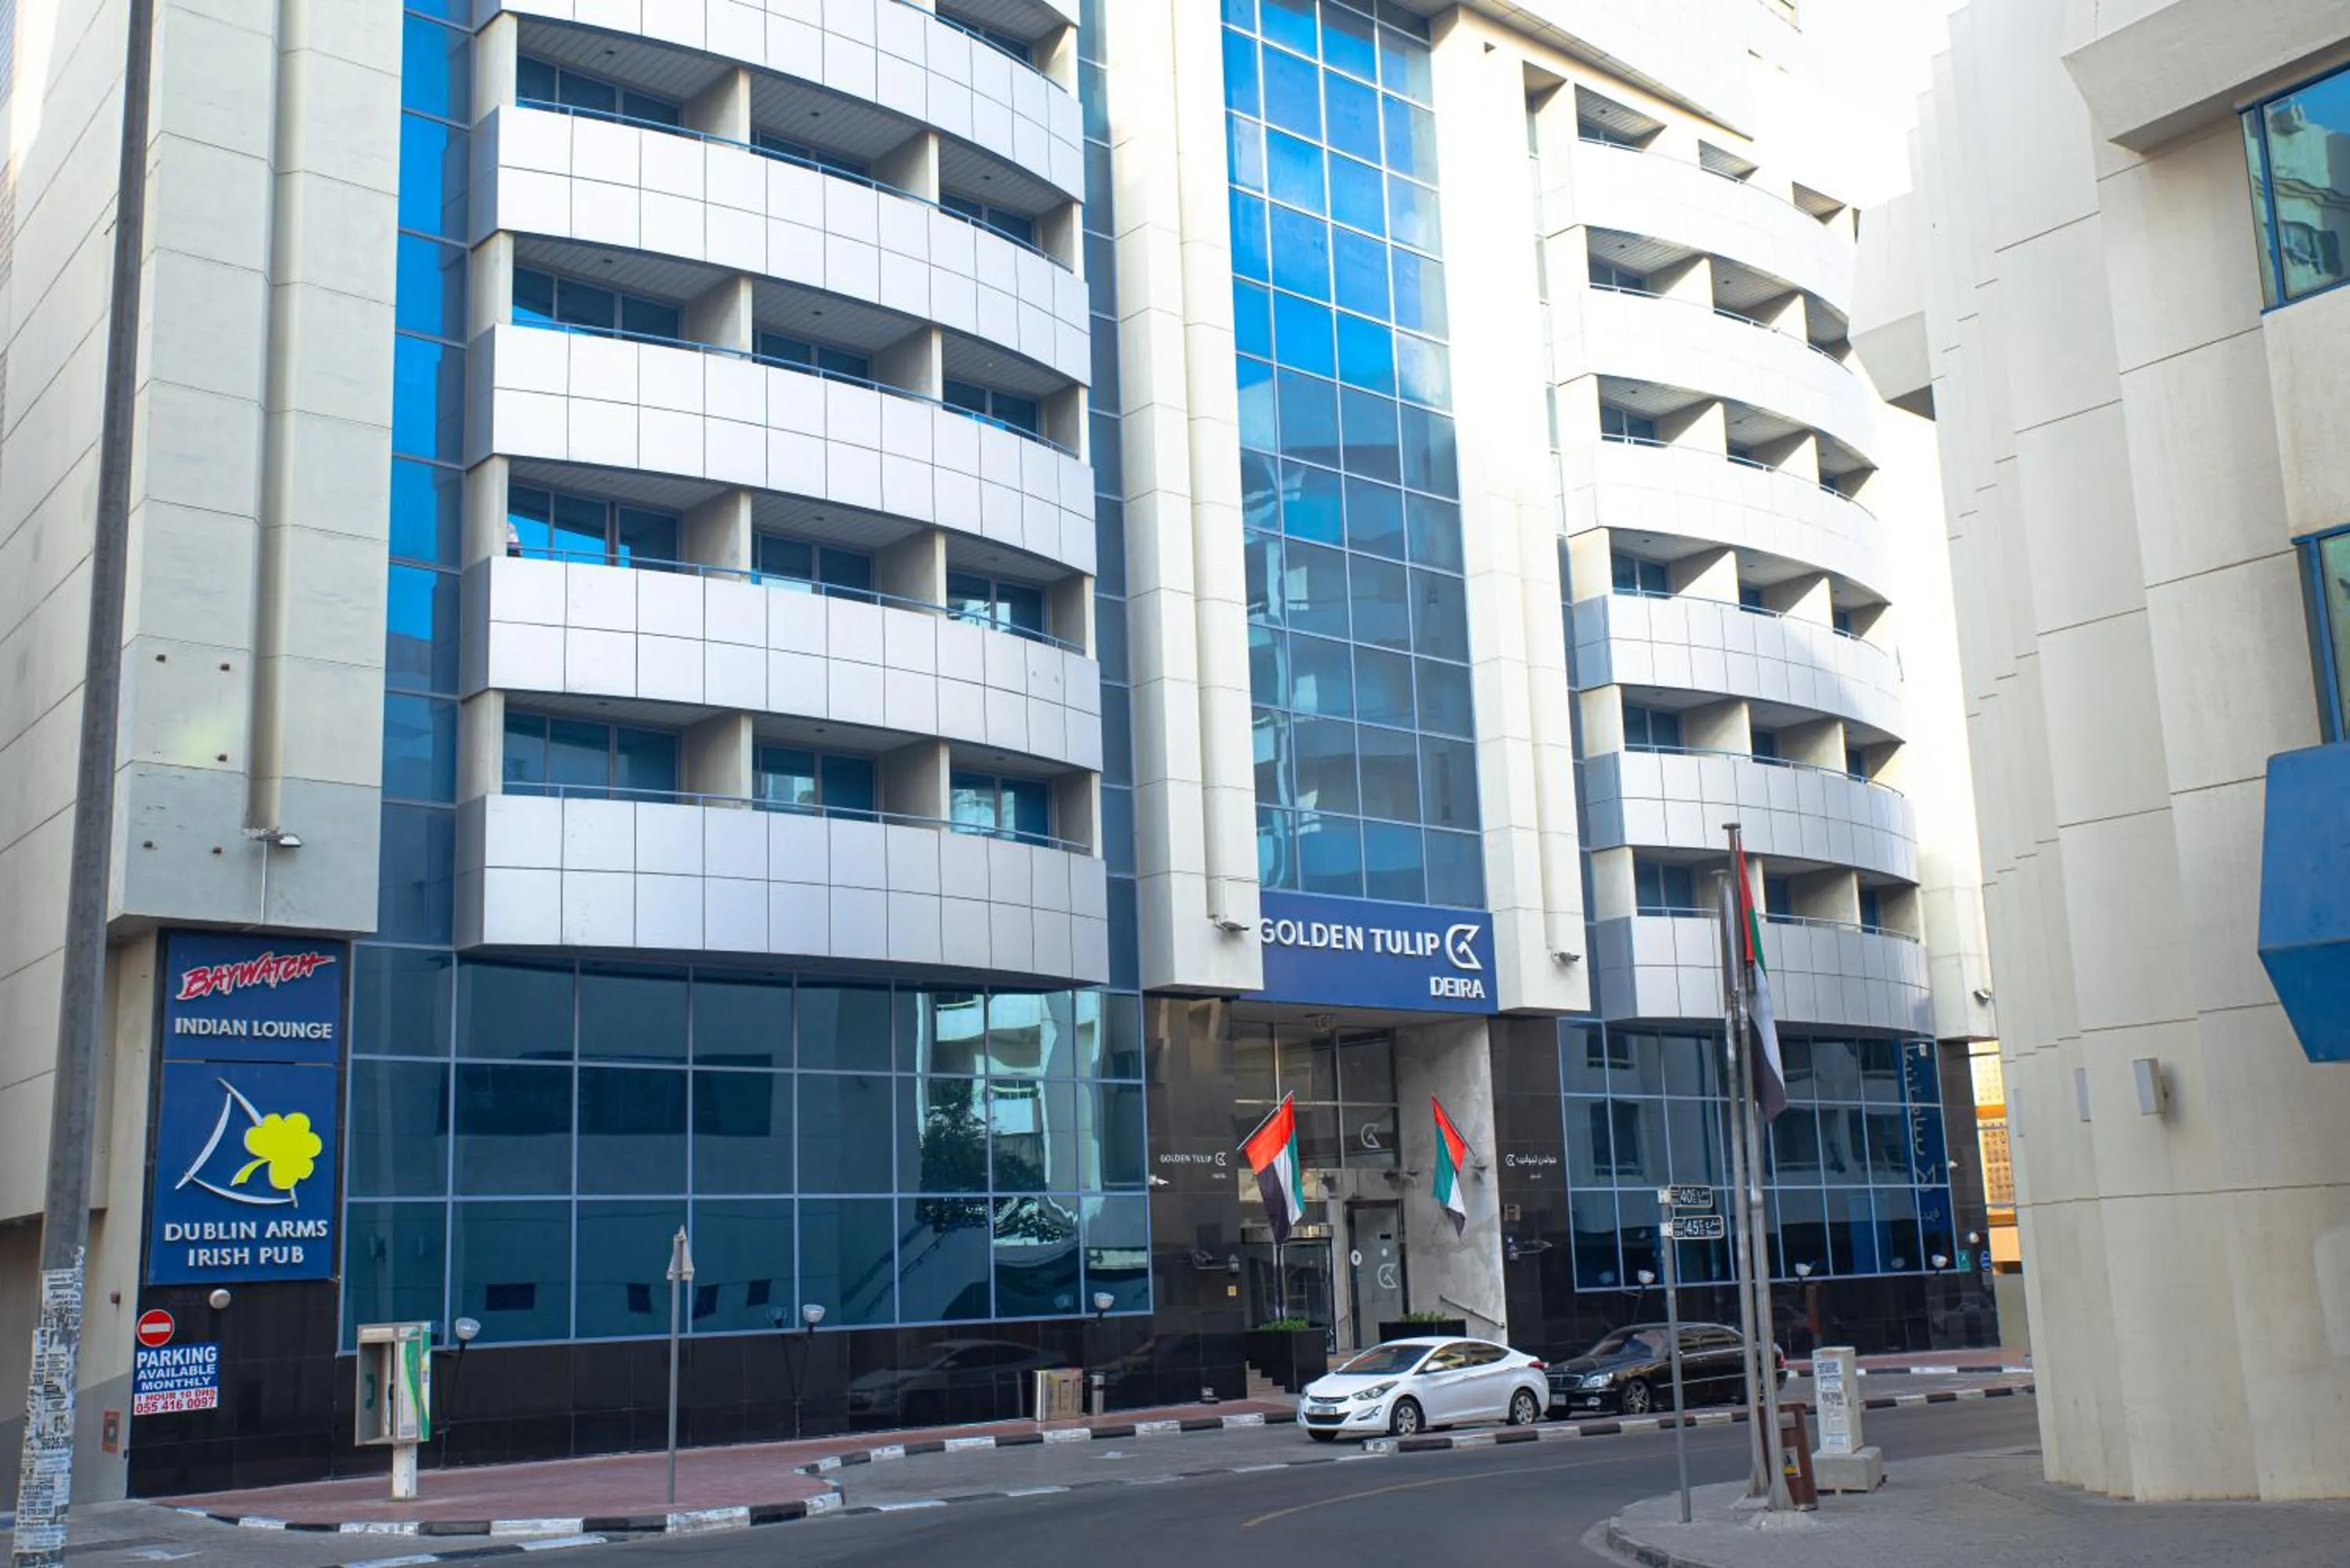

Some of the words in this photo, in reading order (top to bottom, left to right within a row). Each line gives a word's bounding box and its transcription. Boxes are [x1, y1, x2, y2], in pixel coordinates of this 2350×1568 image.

[1260, 917, 1365, 952] GOLDEN
[1368, 927, 1441, 957] TULIP
[175, 952, 336, 1000] BAYWATCH
[1429, 976, 1486, 999] DEIRA
[174, 1017, 248, 1037] INDIAN
[252, 1021, 333, 1039] LOUNGE
[1160, 1154, 1191, 1163] GOLDEN
[1192, 1154, 1212, 1163] TULIP
[164, 1221, 257, 1242] DUBLIN
[265, 1219, 329, 1239] ARMS
[187, 1247, 250, 1267] IRISH
[258, 1245, 305, 1265] PUB
[136, 1346, 218, 1368] PARKING
[137, 1364, 216, 1381] AVAILABLE
[141, 1376, 212, 1391] MONTHLY
[136, 1401, 158, 1414] 055
[162, 1400, 183, 1411] 416
[187, 1396, 215, 1409] 0097
[146, 1392, 176, 1402] HOUR
